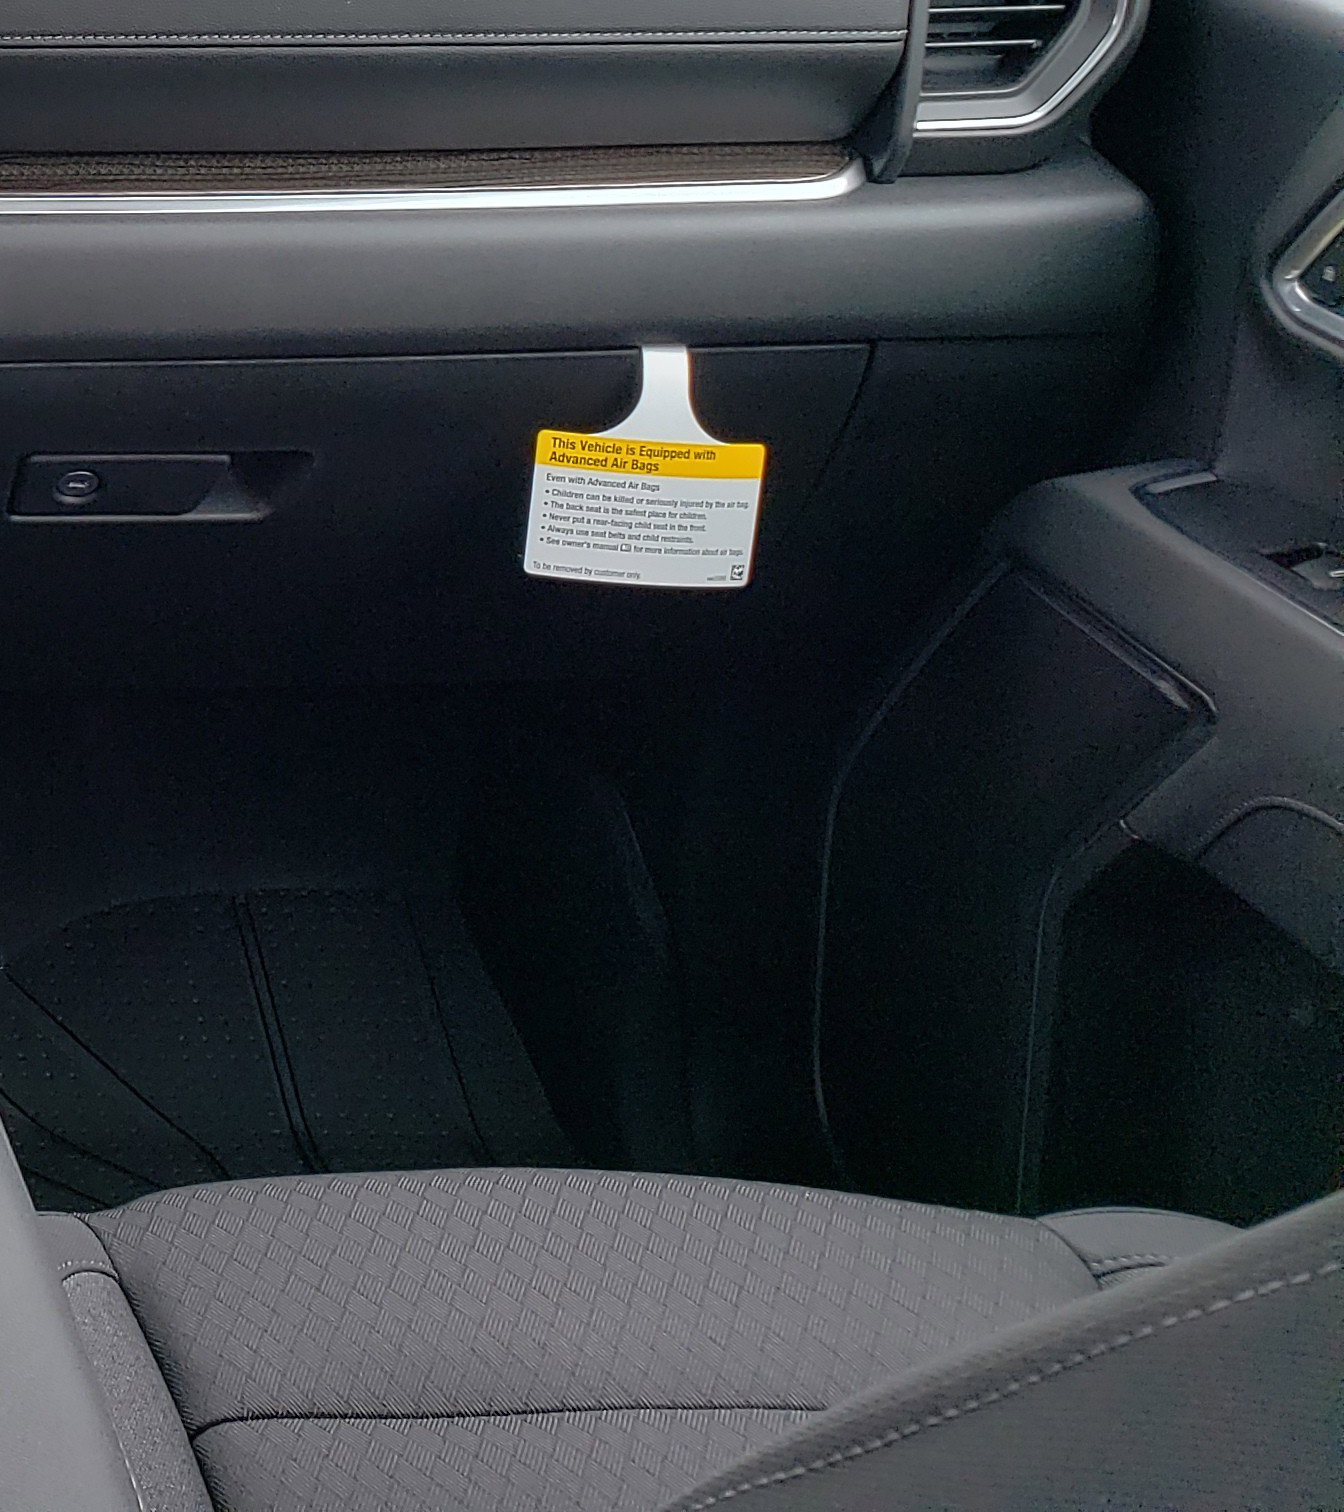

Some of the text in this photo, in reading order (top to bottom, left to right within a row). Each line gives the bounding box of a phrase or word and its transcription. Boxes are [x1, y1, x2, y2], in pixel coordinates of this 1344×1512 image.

[552, 437, 716, 460] This Vehicle is Equipped with
[549, 451, 660, 473] Advanced Air Bags
[546, 473, 566, 482] Even
[568, 477, 586, 485] with
[587, 478, 626, 489] Advanced
[641, 483, 660, 492] Bags
[552, 489, 584, 499] Children
[646, 498, 678, 508] seriously
[680, 500, 705, 508] injured
[550, 501, 564, 509] The
[586, 505, 602, 513] seat
[679, 512, 707, 520] children.
[547, 525, 574, 535] Always
[549, 513, 571, 521] Never
[572, 516, 585, 524] put
[593, 519, 633, 529] rear-facing
[546, 537, 560, 545] See
[562, 540, 591, 548] owner's
[533, 561, 541, 569] To
[553, 565, 582, 573] removed
[584, 567, 592, 575] by
[594, 569, 625, 577] customer
